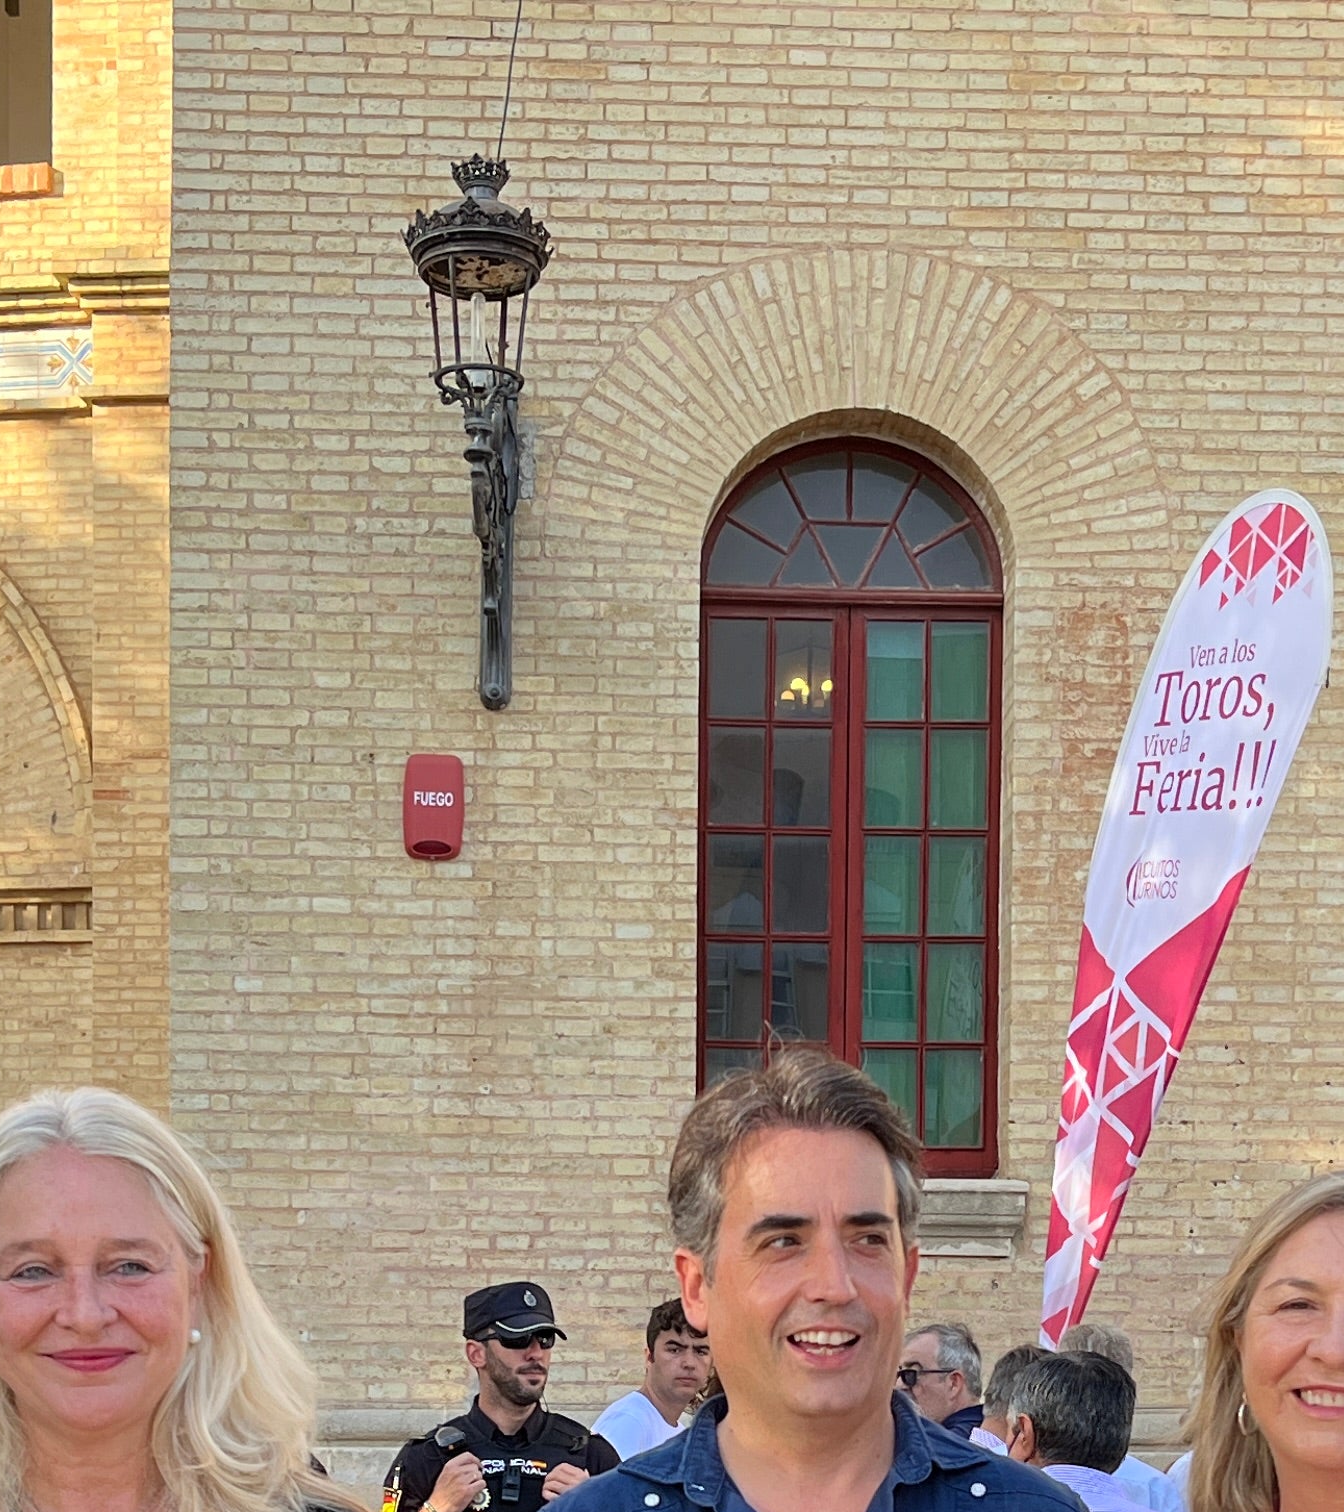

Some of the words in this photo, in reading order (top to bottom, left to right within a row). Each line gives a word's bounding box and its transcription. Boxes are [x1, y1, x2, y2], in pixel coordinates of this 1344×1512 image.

[1190, 644, 1216, 669] Ven
[1218, 646, 1228, 664] a
[1231, 638, 1256, 663] los
[1154, 670, 1275, 731] Toros,
[1144, 733, 1177, 758] Vive
[1179, 729, 1191, 754] la
[1128, 739, 1277, 816] Feria!!!
[413, 790, 455, 807] FUEGO
[482, 1465, 548, 1476] NACNAL
